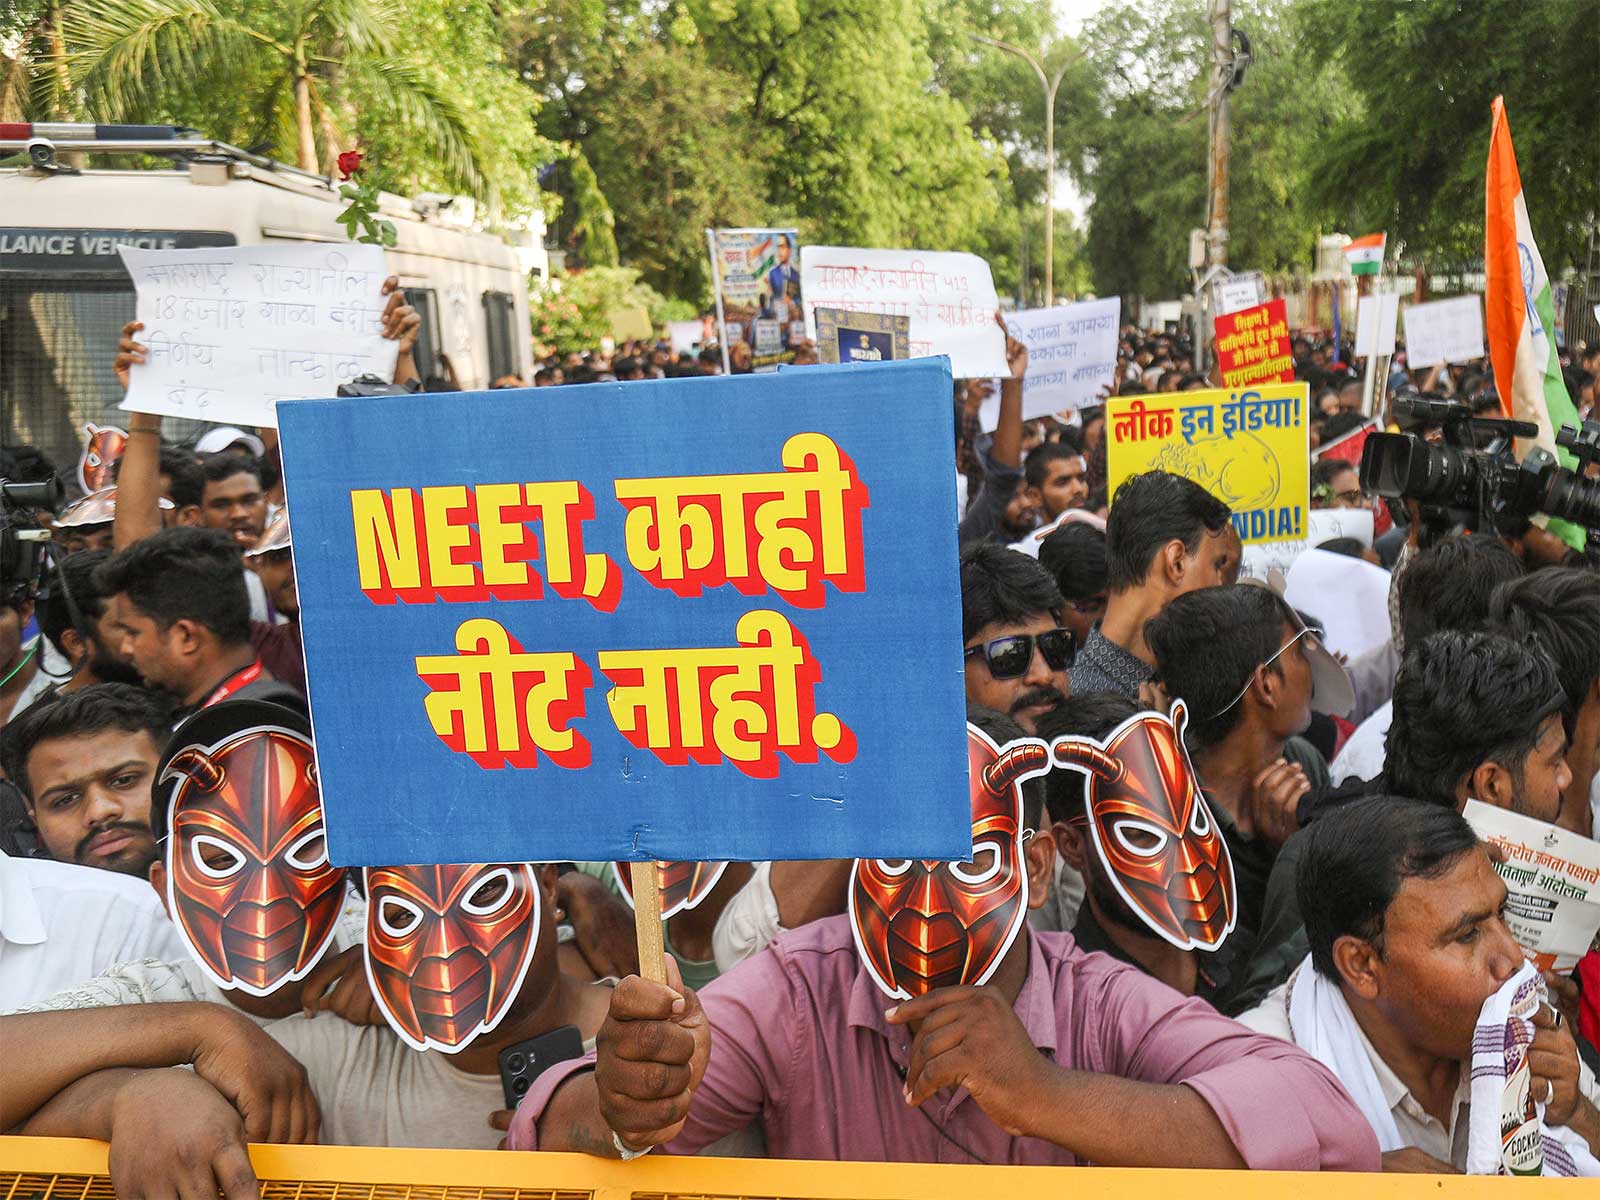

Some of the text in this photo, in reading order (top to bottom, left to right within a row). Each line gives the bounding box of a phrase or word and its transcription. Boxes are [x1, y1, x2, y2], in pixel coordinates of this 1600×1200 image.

[153, 295, 176, 321] 18
[1113, 391, 1301, 446] लीक इन इंडिया!
[351, 432, 858, 606] NEET, काही
[1231, 506, 1301, 541] NDIA!
[415, 609, 848, 768] नीट नाही.
